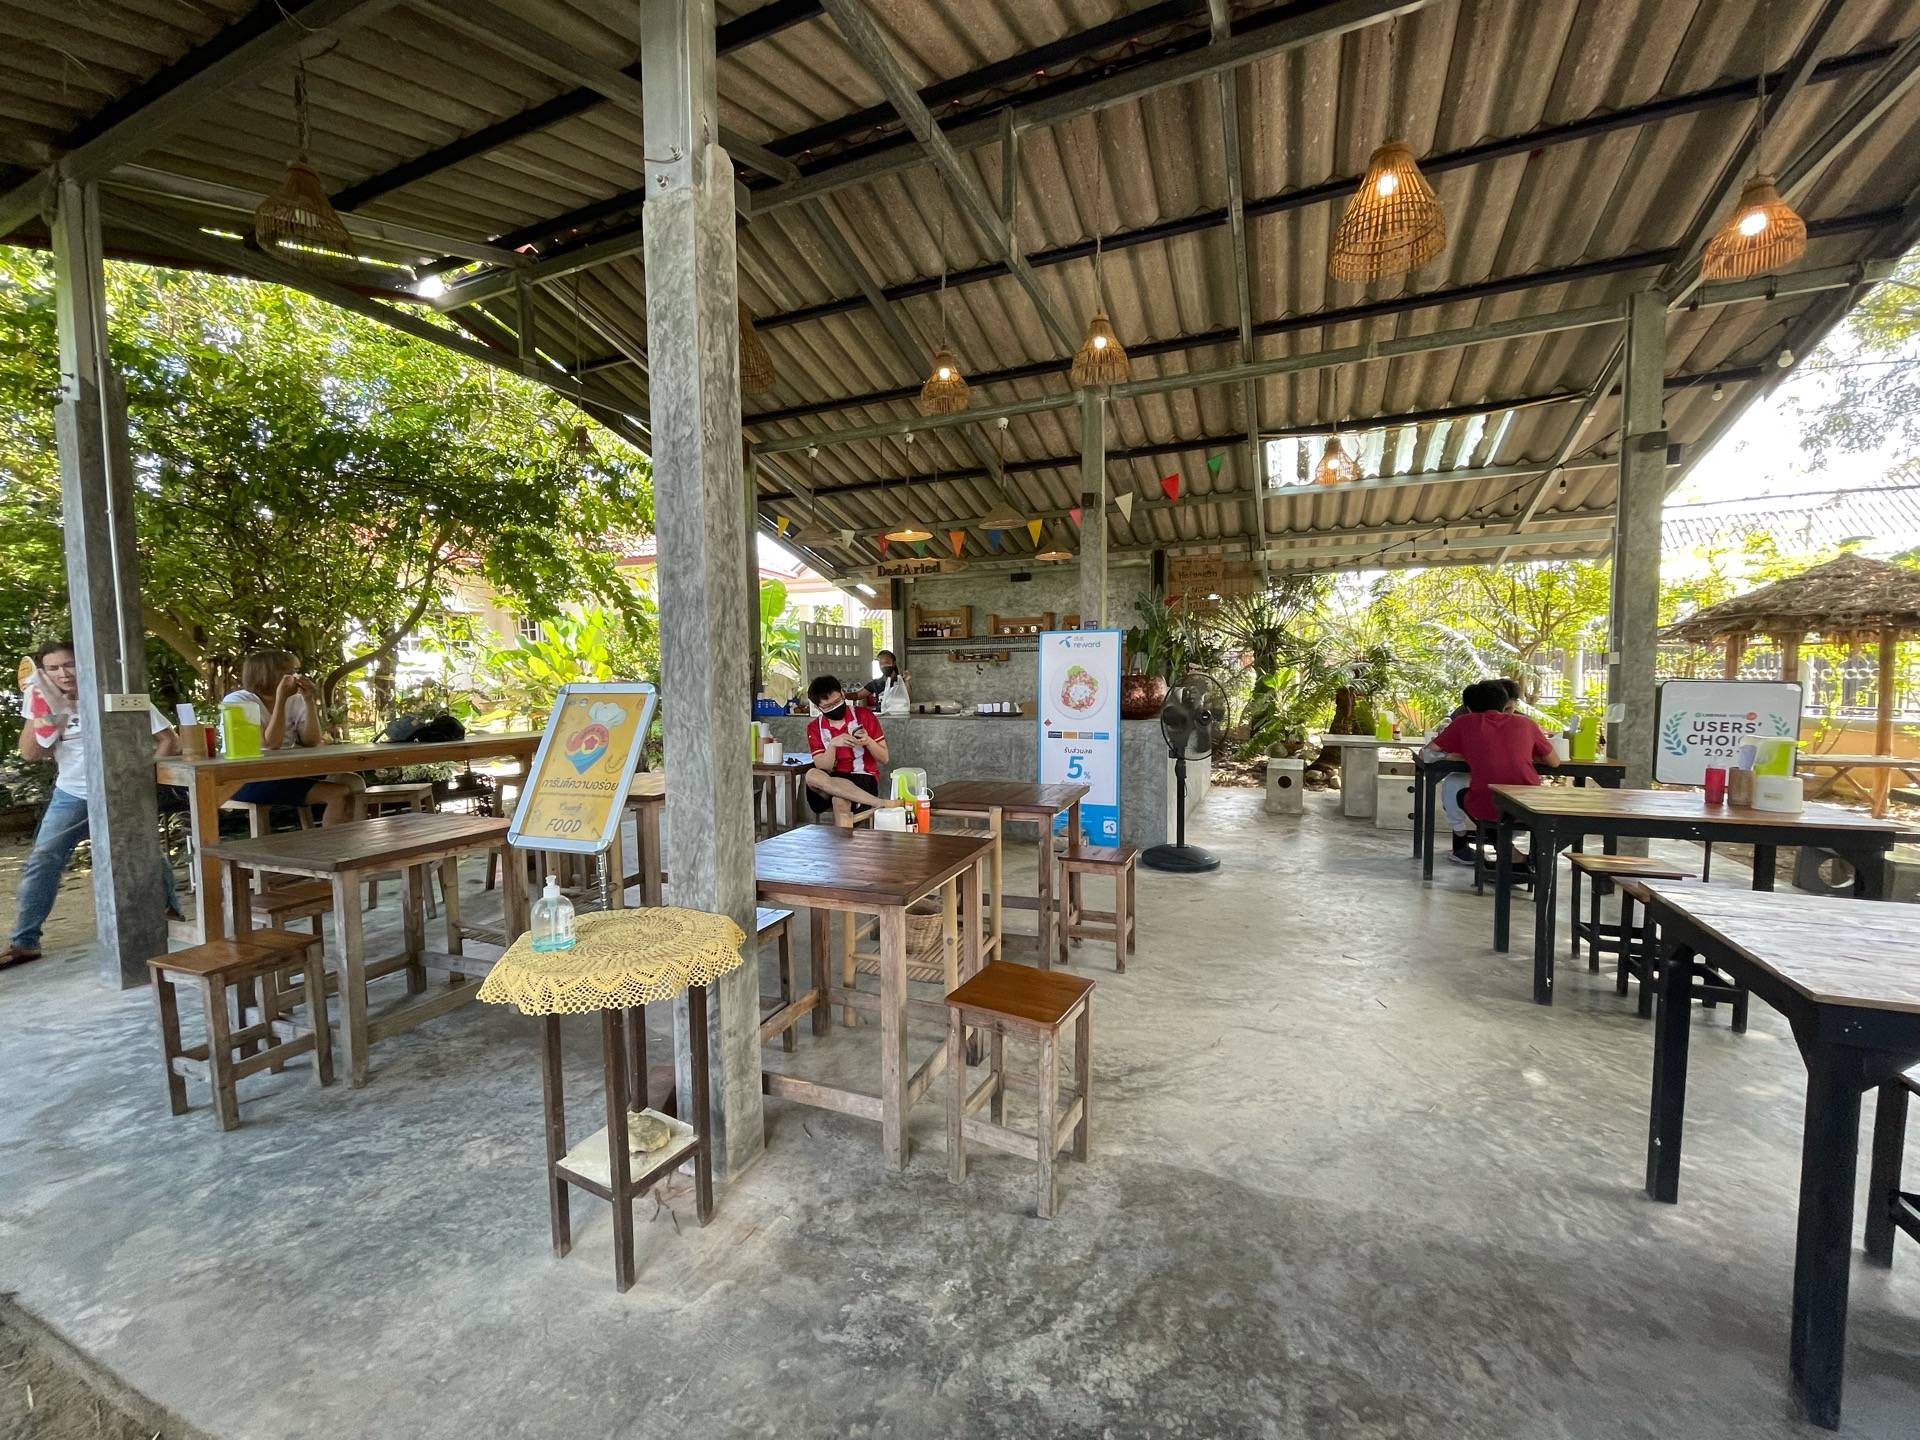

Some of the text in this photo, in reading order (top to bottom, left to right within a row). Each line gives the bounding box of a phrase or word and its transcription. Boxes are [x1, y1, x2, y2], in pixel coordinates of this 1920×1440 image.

[1073, 641, 1101, 649] reward
[1692, 720, 1762, 734] USERS'
[1704, 748, 1740, 758] 202
[545, 818, 582, 833] FOOD
